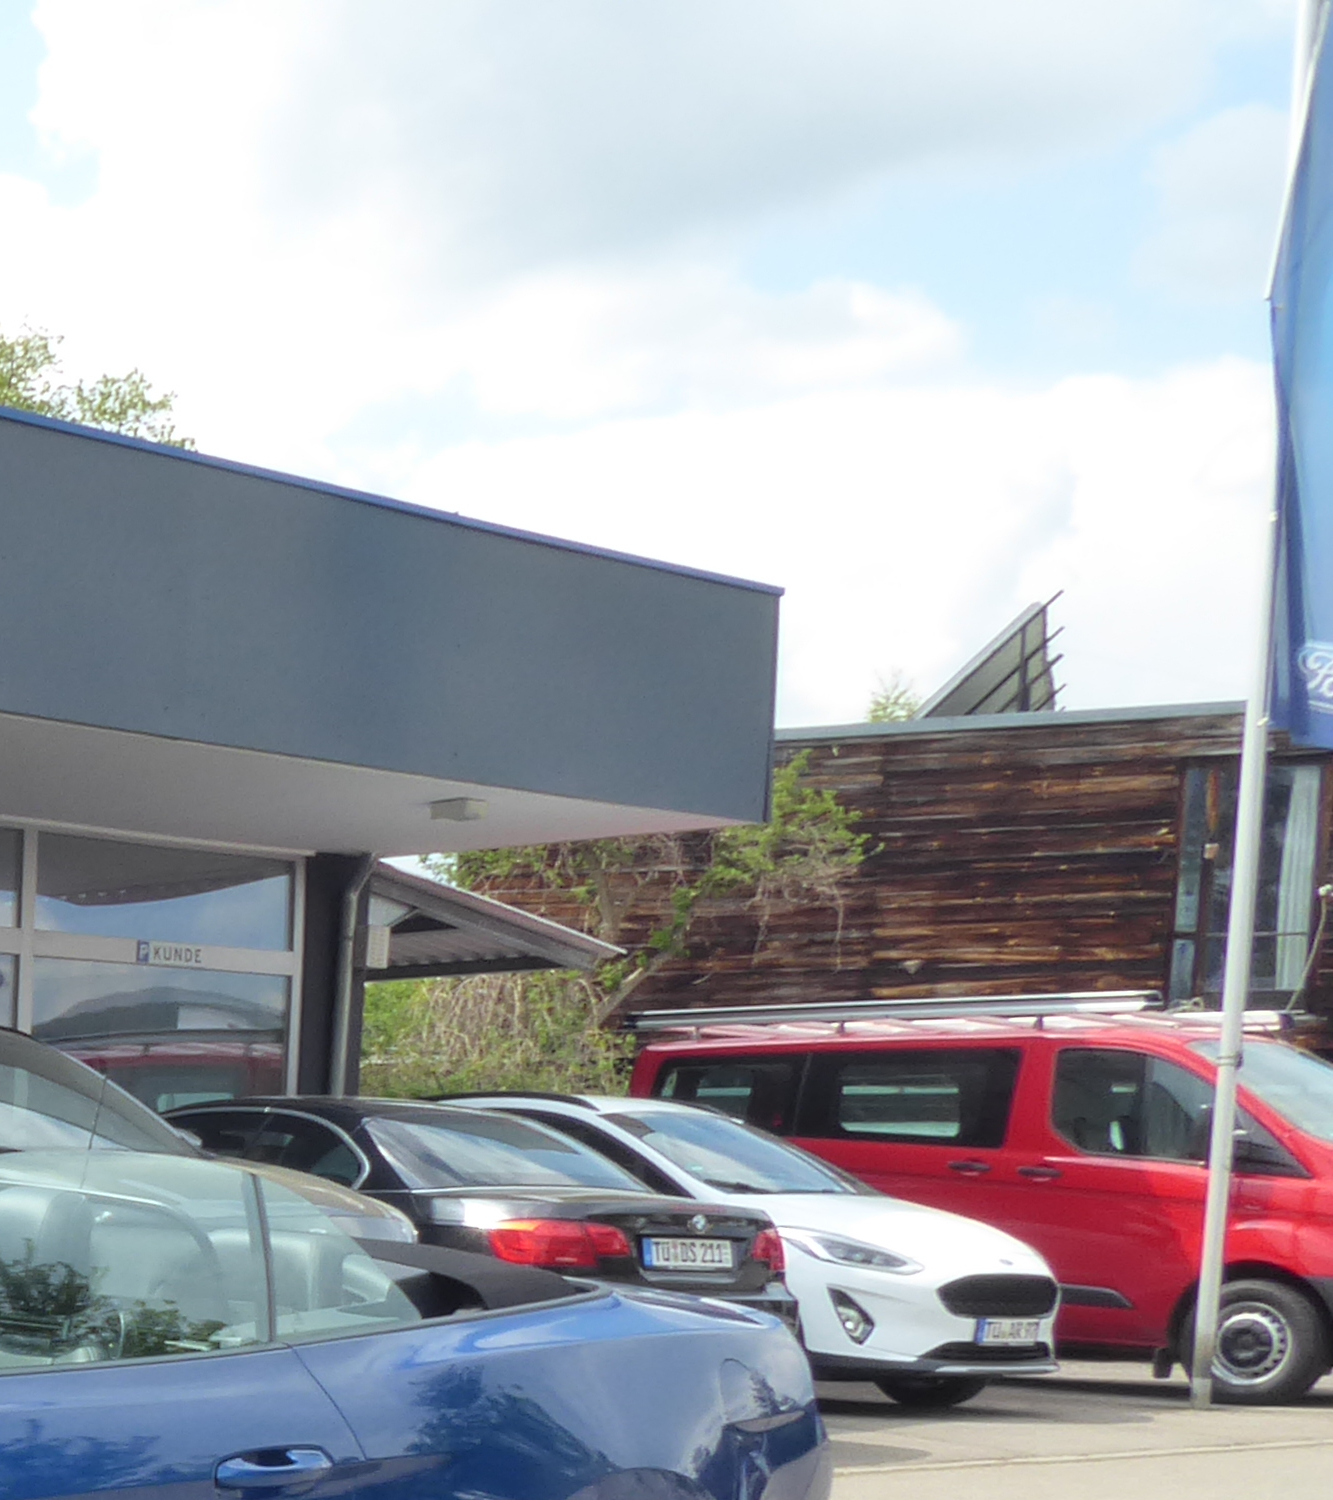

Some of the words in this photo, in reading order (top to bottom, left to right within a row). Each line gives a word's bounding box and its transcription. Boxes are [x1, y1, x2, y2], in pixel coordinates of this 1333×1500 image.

[153, 946, 202, 963] KUNDE
[679, 1241, 697, 1263] DS
[700, 1242, 723, 1263] 211
